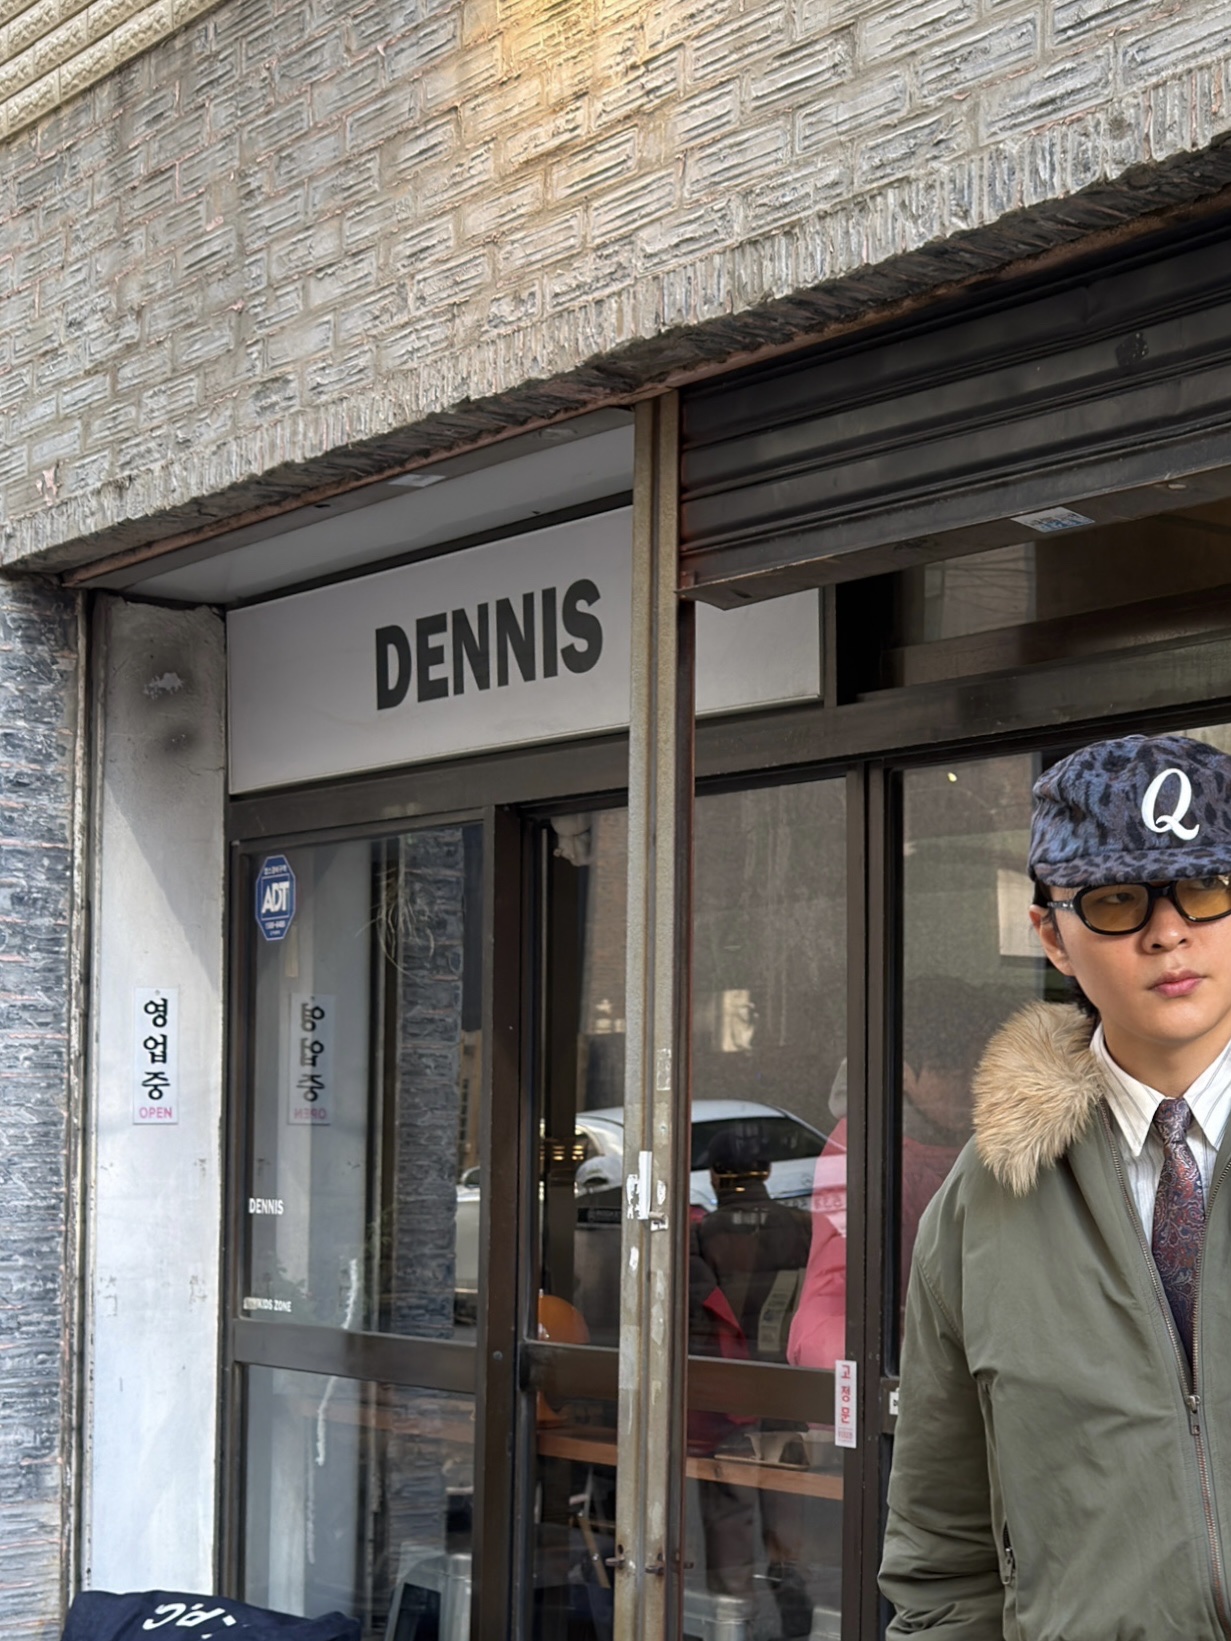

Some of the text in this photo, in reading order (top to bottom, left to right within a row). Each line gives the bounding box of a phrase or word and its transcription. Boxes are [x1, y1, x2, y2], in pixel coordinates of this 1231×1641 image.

[376, 579, 603, 711] DENNIS
[1141, 768, 1200, 840] Q
[261, 880, 291, 915] ADT
[141, 997, 171, 1101] 영업중
[139, 1106, 173, 1120] OPEN
[248, 1197, 285, 1216] DENNIS
[274, 1299, 292, 1313] ZONE
[840, 1364, 851, 1424] 고정문
